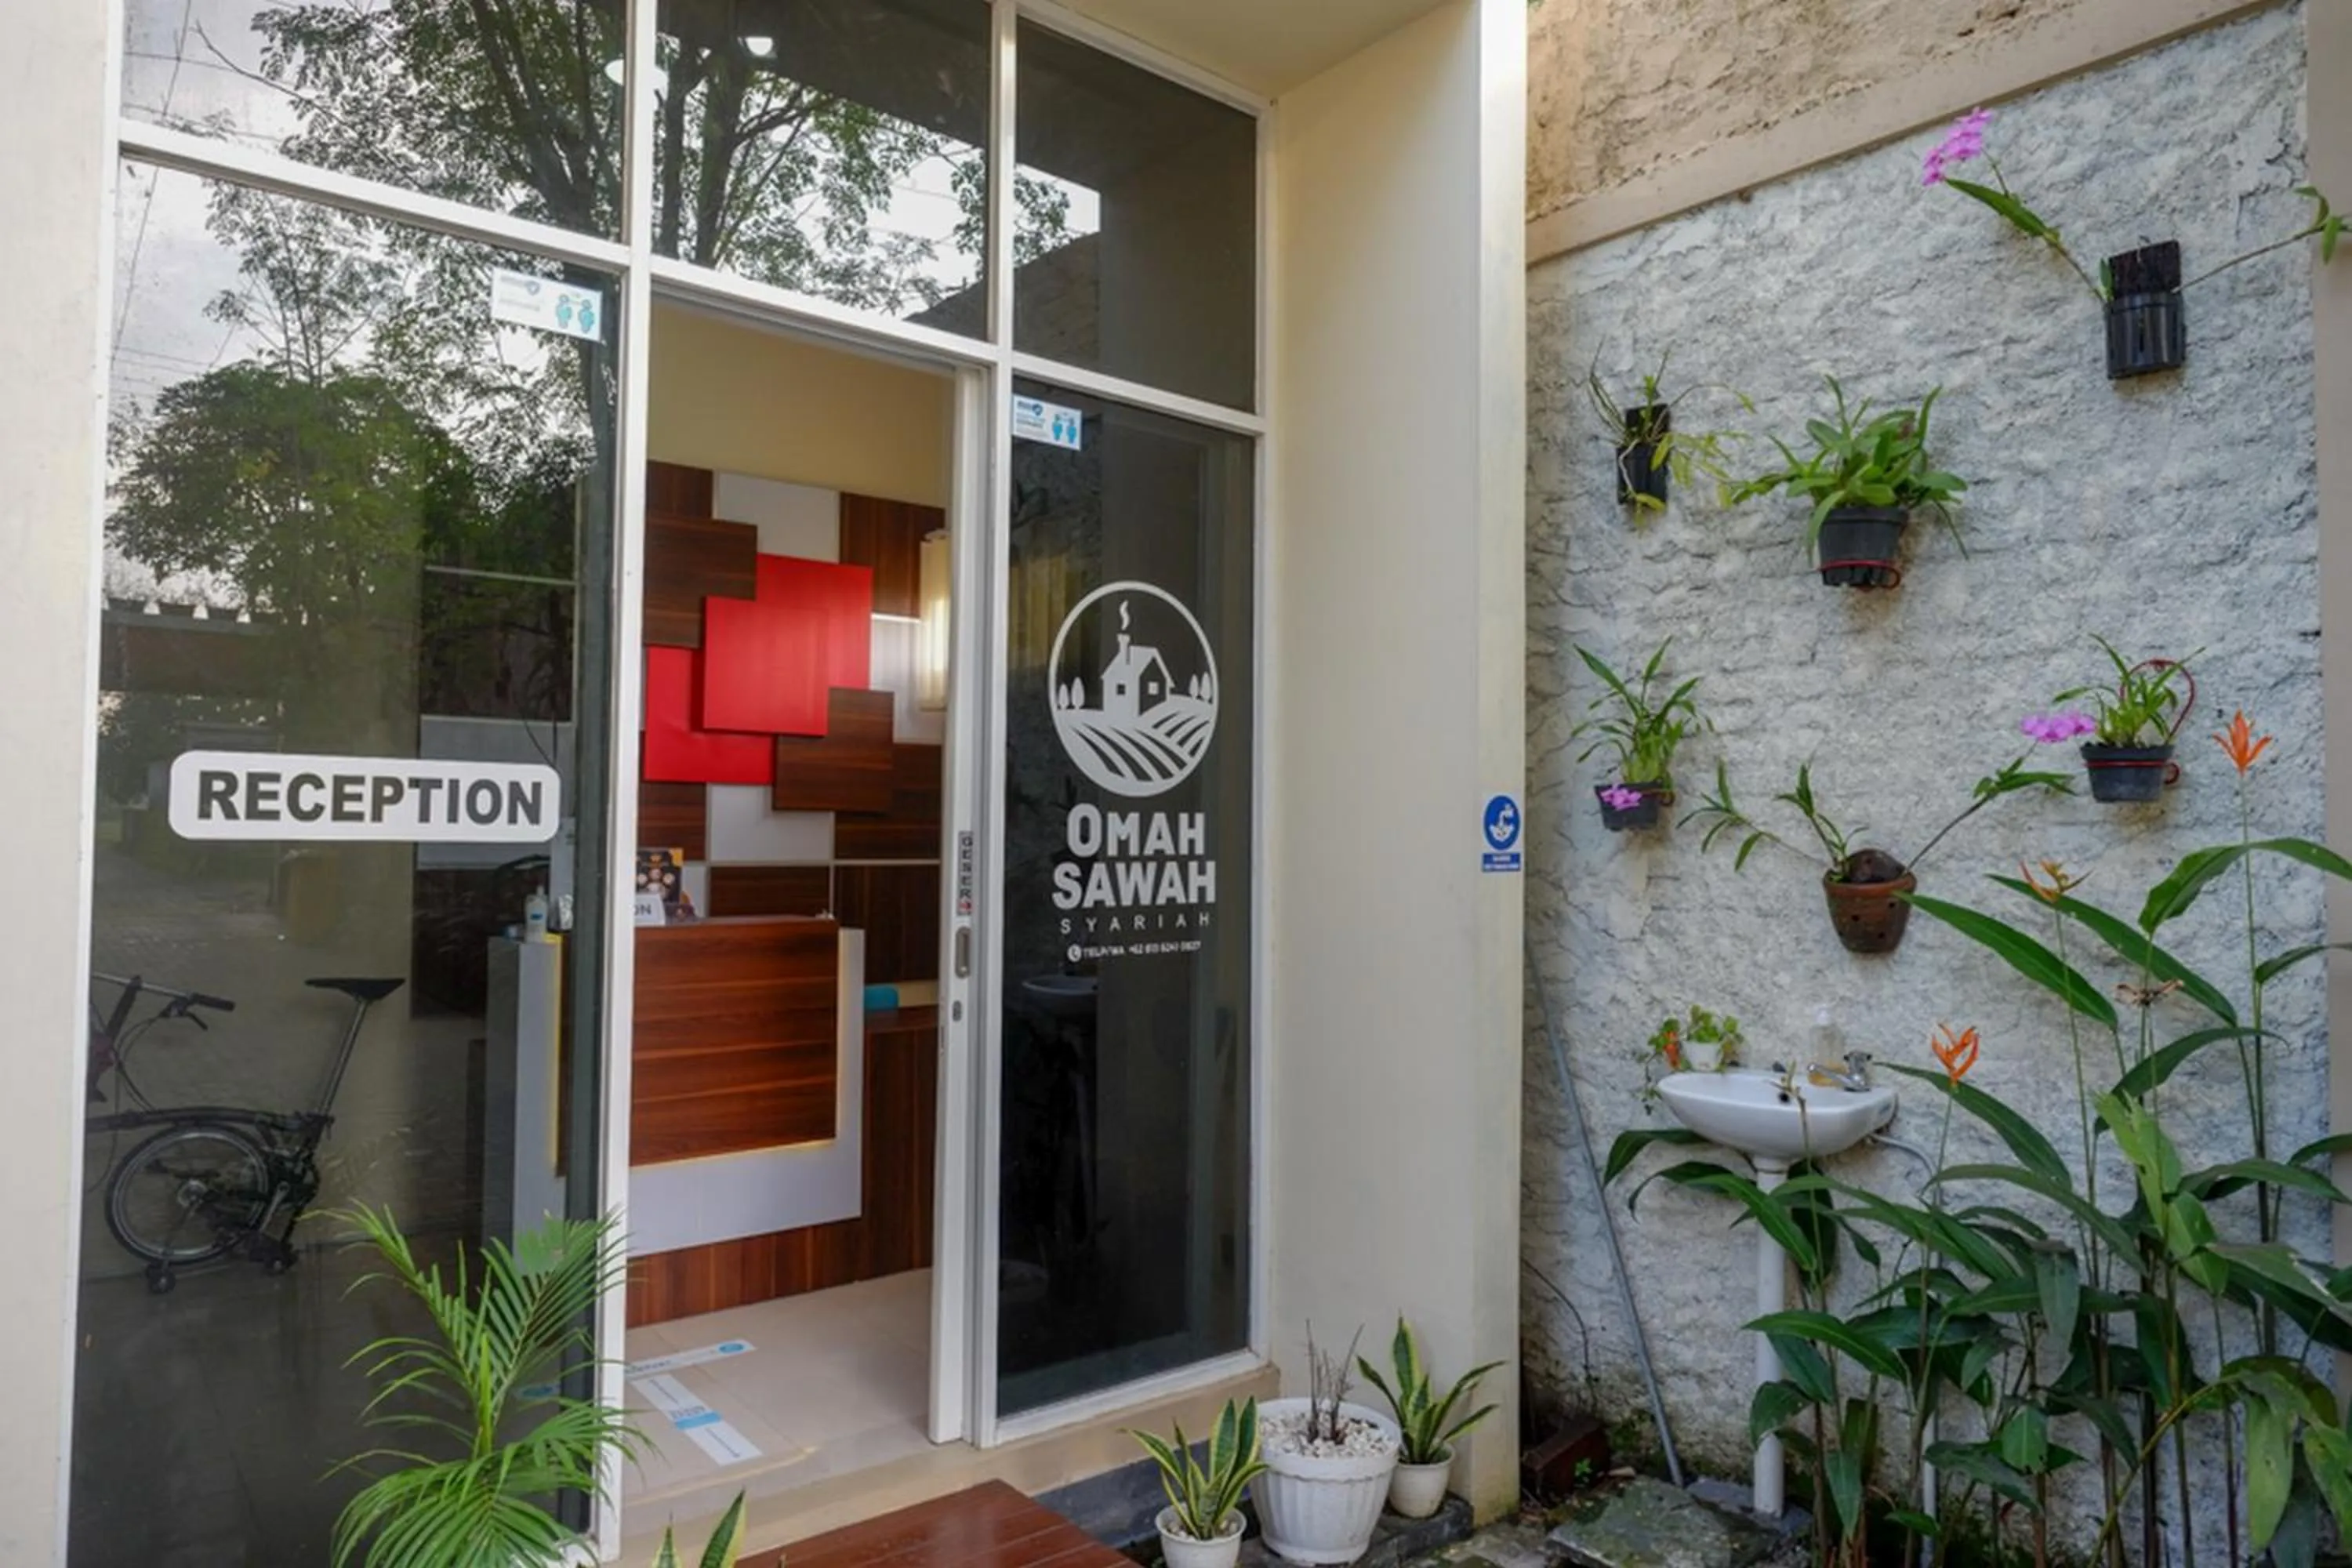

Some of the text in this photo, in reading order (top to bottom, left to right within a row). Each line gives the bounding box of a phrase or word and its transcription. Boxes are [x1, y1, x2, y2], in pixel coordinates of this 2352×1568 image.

[198, 770, 543, 826] RECEPTION
[1067, 803, 1205, 858] OMAH
[1051, 861, 1216, 910] SAWAH
[1060, 913, 1210, 935] SYARIAH
